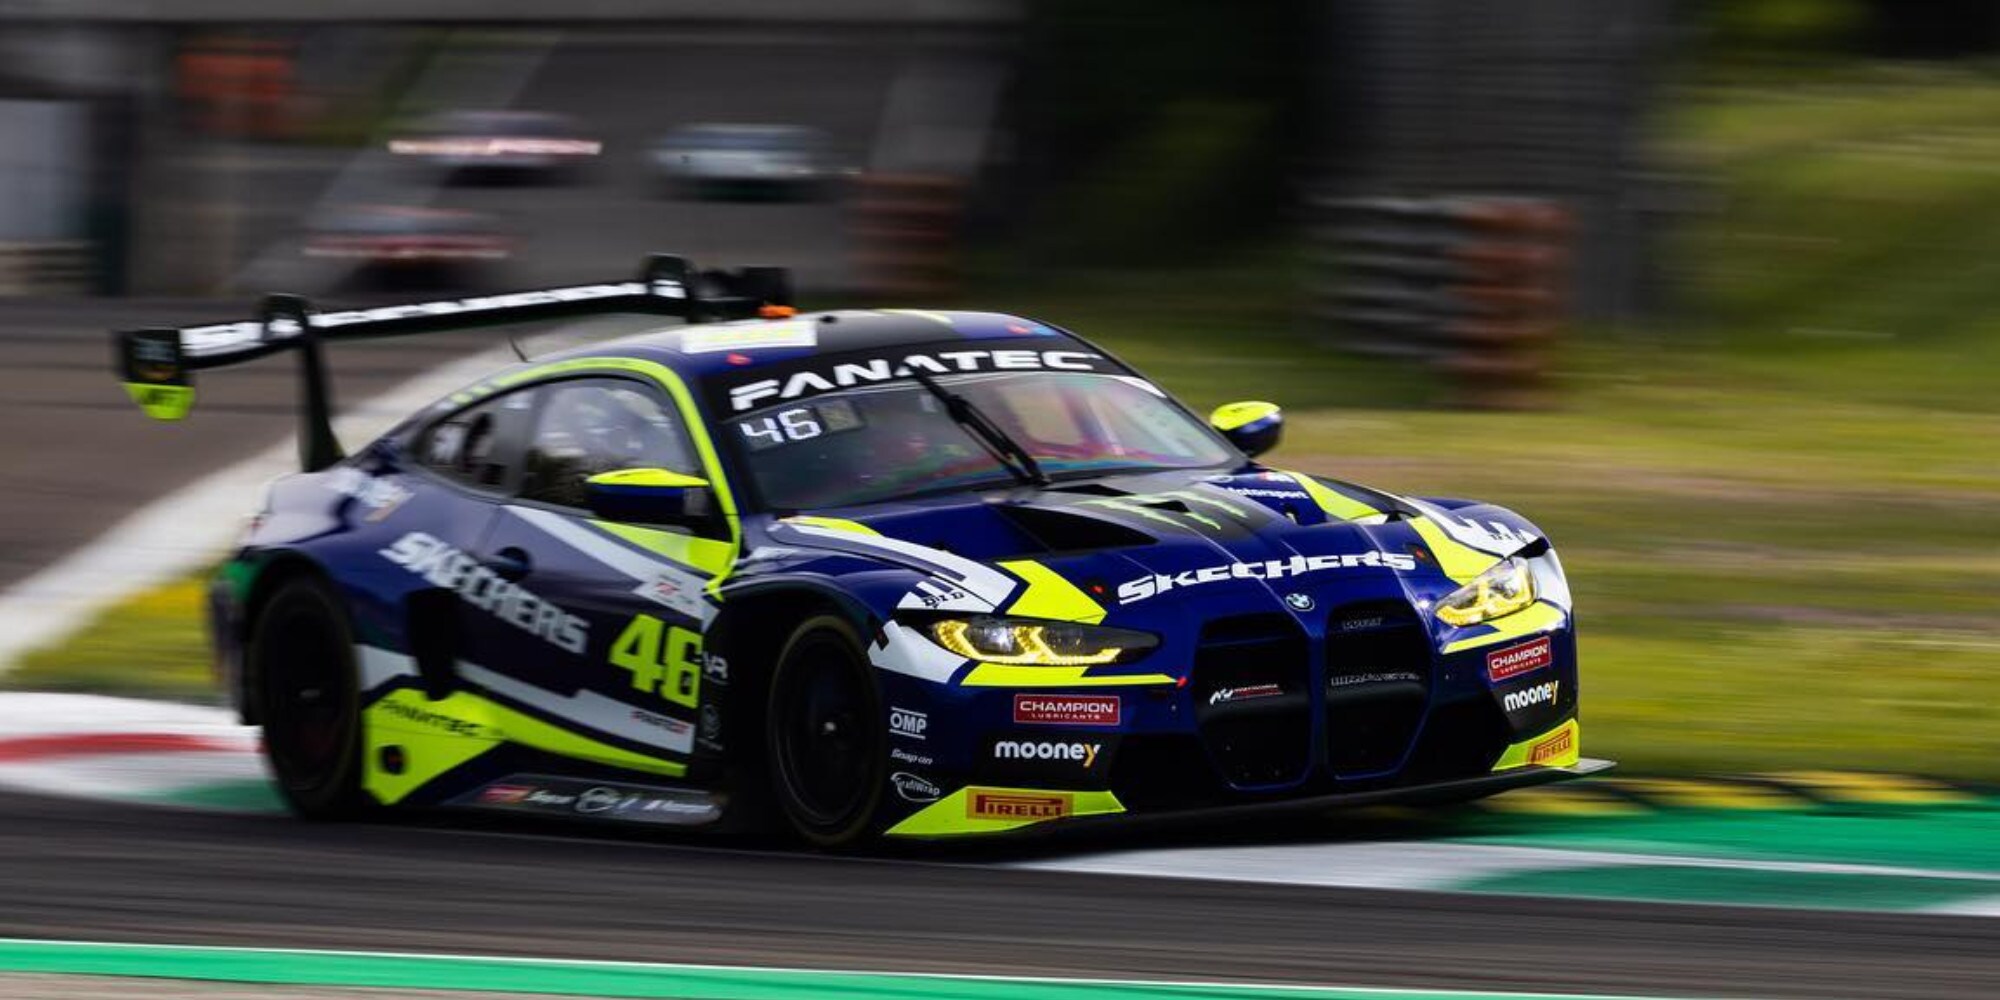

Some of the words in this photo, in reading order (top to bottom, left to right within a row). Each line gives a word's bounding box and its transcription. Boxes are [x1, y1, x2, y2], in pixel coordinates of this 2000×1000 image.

[731, 350, 1100, 411] FANATEC
[740, 408, 823, 444] 46
[1117, 551, 1416, 604] SKECHERS
[378, 531, 590, 655] SKECHERS
[608, 612, 704, 710] 46
[1491, 644, 1548, 669] CHAMPION
[1019, 700, 1114, 714] CHAMPION
[1504, 681, 1558, 711] mooney
[890, 711, 927, 733] OMP
[995, 741, 1100, 767] mooney
[976, 794, 1063, 817] PIRELLI
